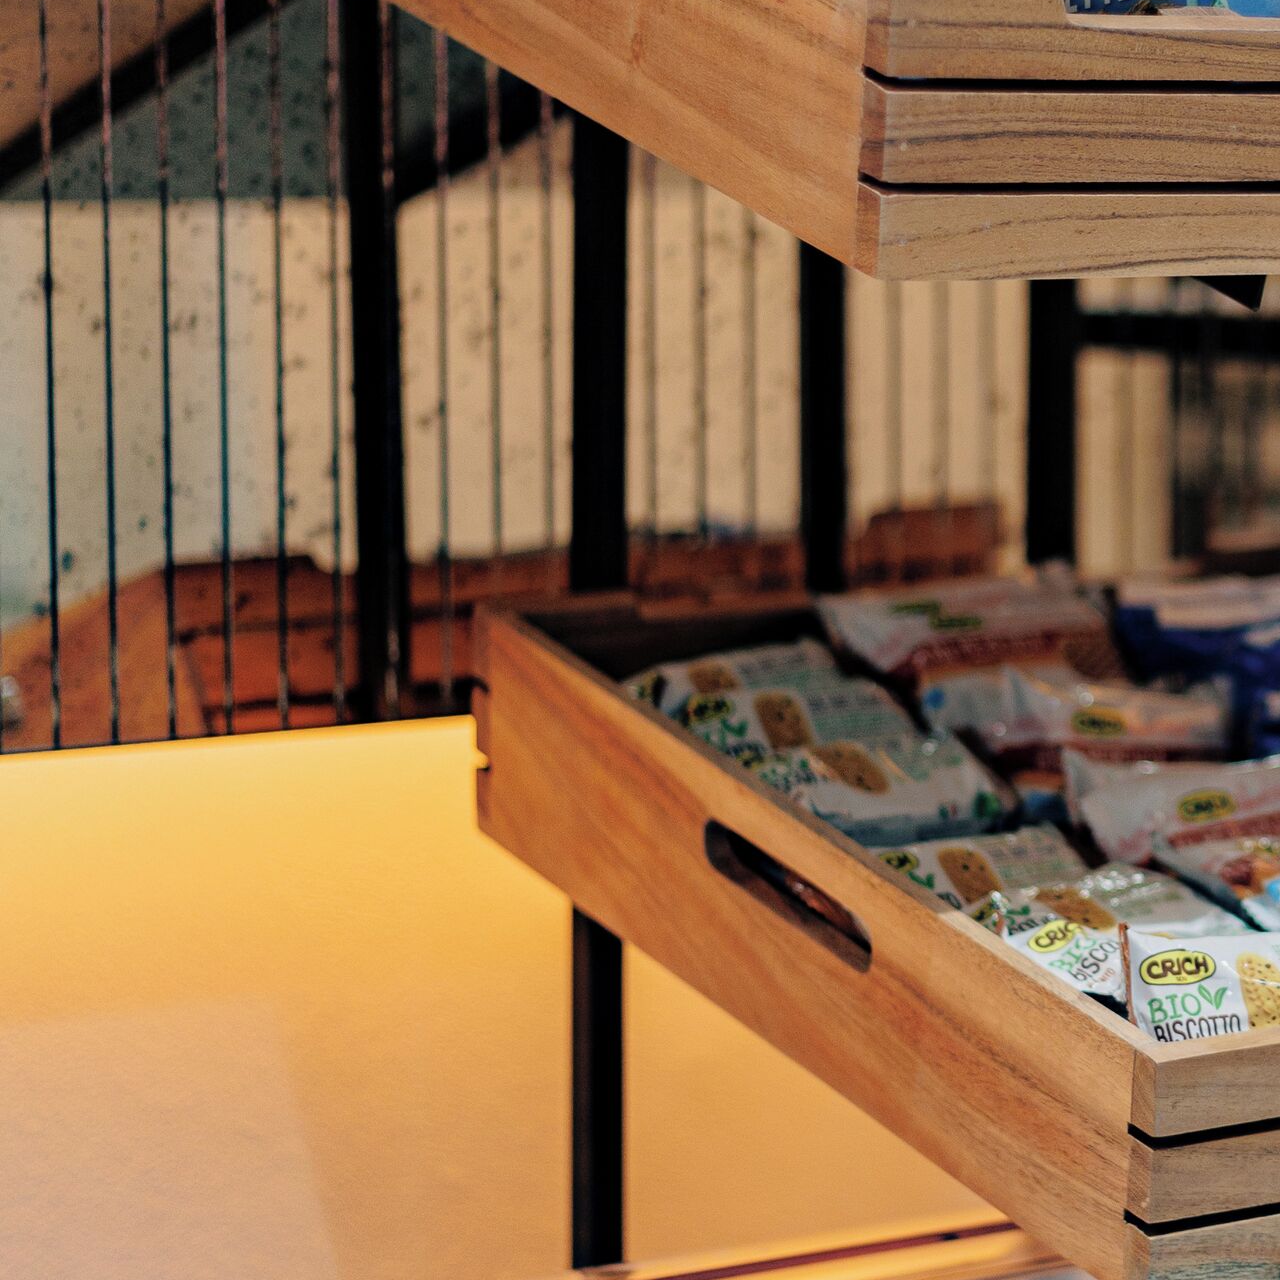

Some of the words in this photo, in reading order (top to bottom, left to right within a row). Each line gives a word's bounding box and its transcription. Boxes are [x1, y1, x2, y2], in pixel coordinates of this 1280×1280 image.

[1146, 956, 1209, 980] CRICH
[1148, 991, 1201, 1024] BIO
[1154, 1013, 1241, 1043] BISCOTTO
